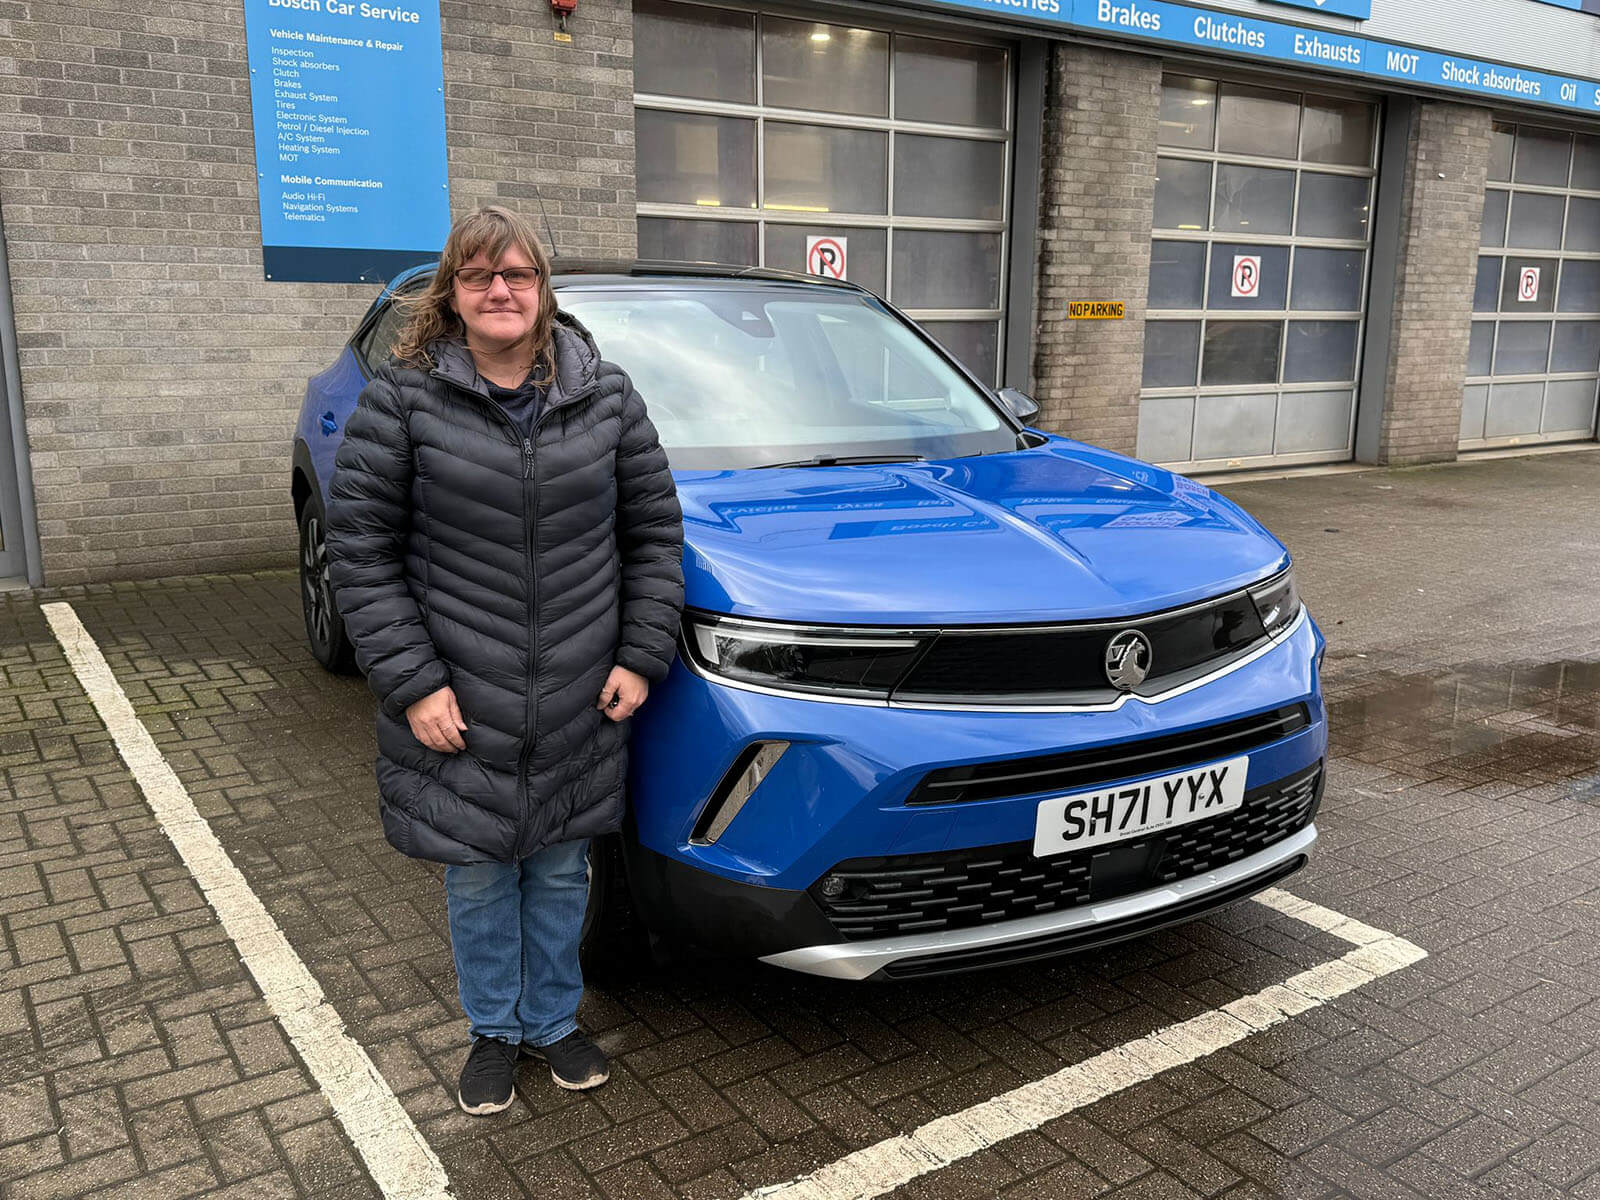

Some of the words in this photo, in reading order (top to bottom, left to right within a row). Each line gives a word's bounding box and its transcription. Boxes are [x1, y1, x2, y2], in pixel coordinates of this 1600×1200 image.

[326, 0, 355, 15] Car
[360, 3, 420, 23] Service
[270, 29, 304, 41] Vehicle
[307, 32, 363, 47] Maintenance
[375, 40, 403, 51] Repair
[272, 47, 314, 58] Inspection
[1098, 0, 1160, 30] Brakes
[1194, 16, 1265, 48] Clutches
[1295, 34, 1360, 64] Exhausts
[1387, 51, 1419, 74] MOT
[1442, 61, 1480, 86] Shock
[1482, 68, 1541, 96] absorbers
[1560, 83, 1576, 102] Oil
[272, 57, 298, 68] Shock
[299, 60, 340, 71] absorbers
[273, 68, 299, 78] Clutch
[274, 79, 302, 89] Brakes
[275, 90, 307, 100] Exhaust
[309, 91, 338, 103] System
[275, 100, 296, 109] Tires
[276, 111, 315, 121] Electronic
[318, 114, 348, 125] System
[277, 122, 302, 131] Petrol
[310, 124, 334, 134] Diesel
[336, 126, 369, 137] Injection
[277, 132, 293, 142] A/C
[295, 133, 325, 145] System
[279, 143, 309, 154] Heating
[311, 145, 340, 156] System
[279, 154, 299, 162] MOT
[280, 175, 312, 185] Mobile
[314, 176, 383, 189] Communication
[282, 192, 305, 201] Audio
[283, 202, 323, 213] Navigation
[326, 204, 359, 214] Systems
[284, 212, 325, 222] Telematics
[1062, 785, 1151, 841] SH71
[1163, 766, 1229, 819] YYX
